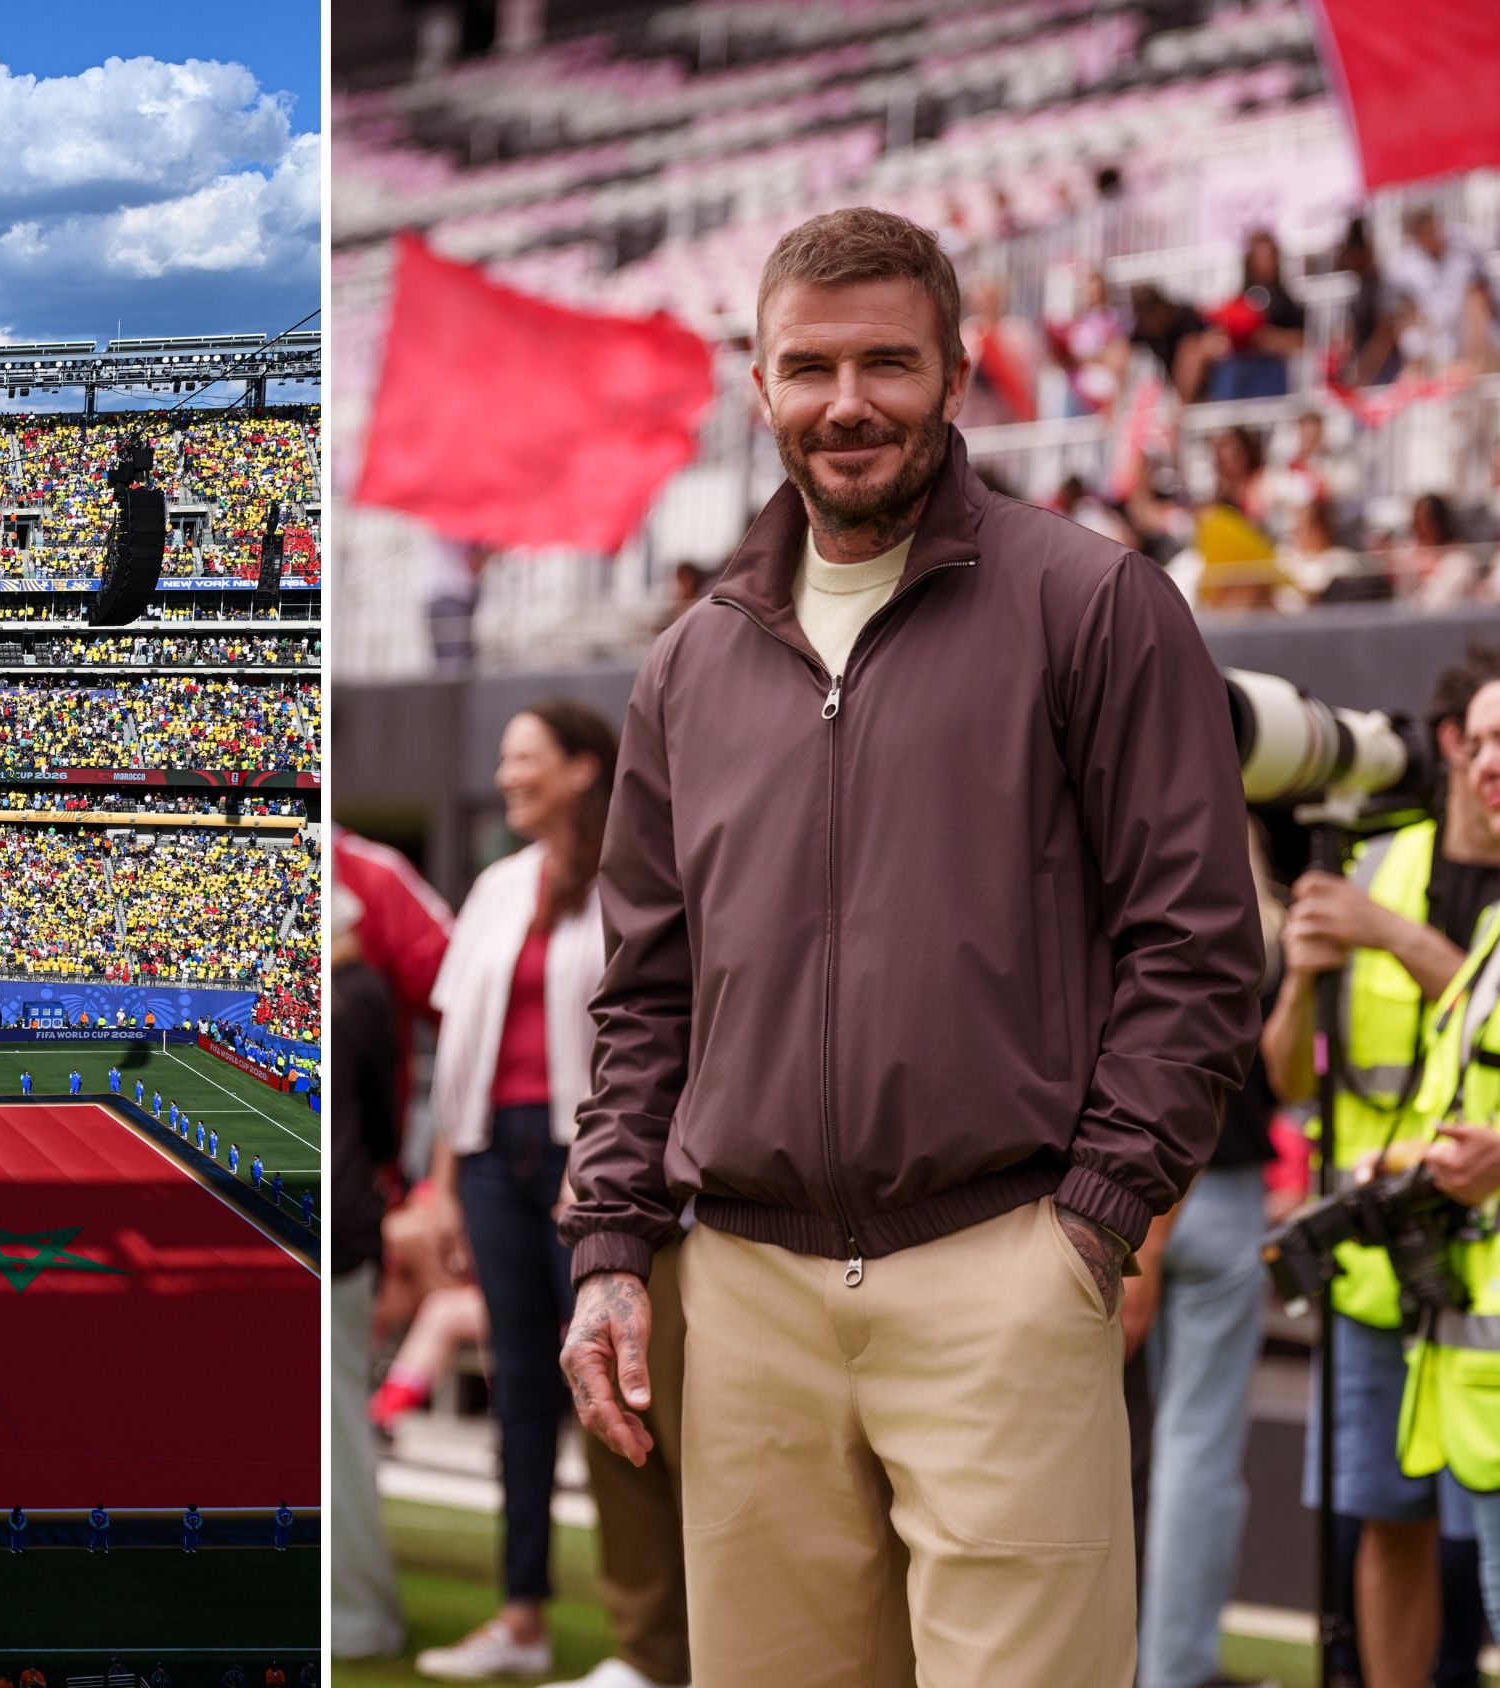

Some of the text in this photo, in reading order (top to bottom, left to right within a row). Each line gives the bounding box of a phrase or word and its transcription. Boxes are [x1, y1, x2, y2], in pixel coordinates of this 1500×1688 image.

[163, 579, 192, 588] NEW
[195, 579, 229, 588] YORK
[113, 772, 146, 781] MOROCCO
[210, 1043, 220, 1055] FIFA
[220, 1050, 238, 1065] WORLD
[239, 1059, 249, 1070] CUP
